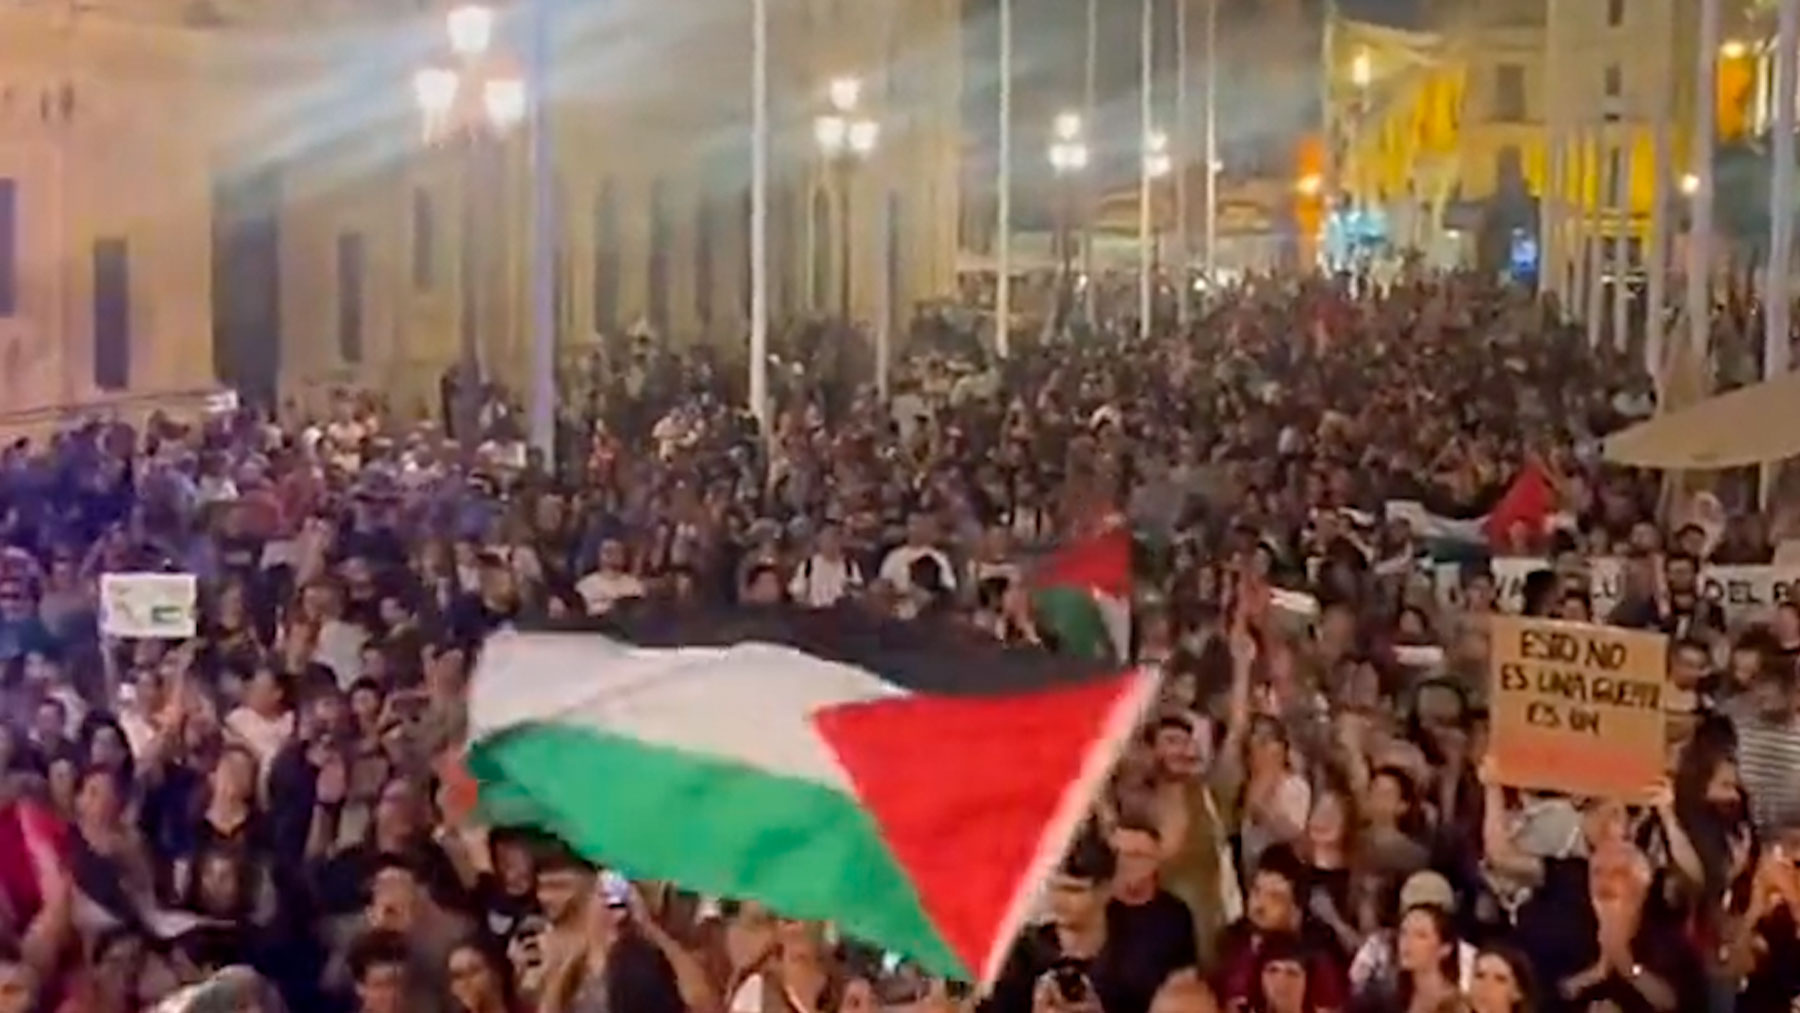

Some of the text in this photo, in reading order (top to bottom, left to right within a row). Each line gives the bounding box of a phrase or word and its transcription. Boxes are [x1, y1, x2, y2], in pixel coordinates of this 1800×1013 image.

[1703, 578, 1763, 604] DEL
[1521, 630, 1626, 670] ESTO NO
[1502, 664, 1528, 690] ES
[1538, 671, 1586, 702] UNA
[1527, 701, 1560, 728] ES
